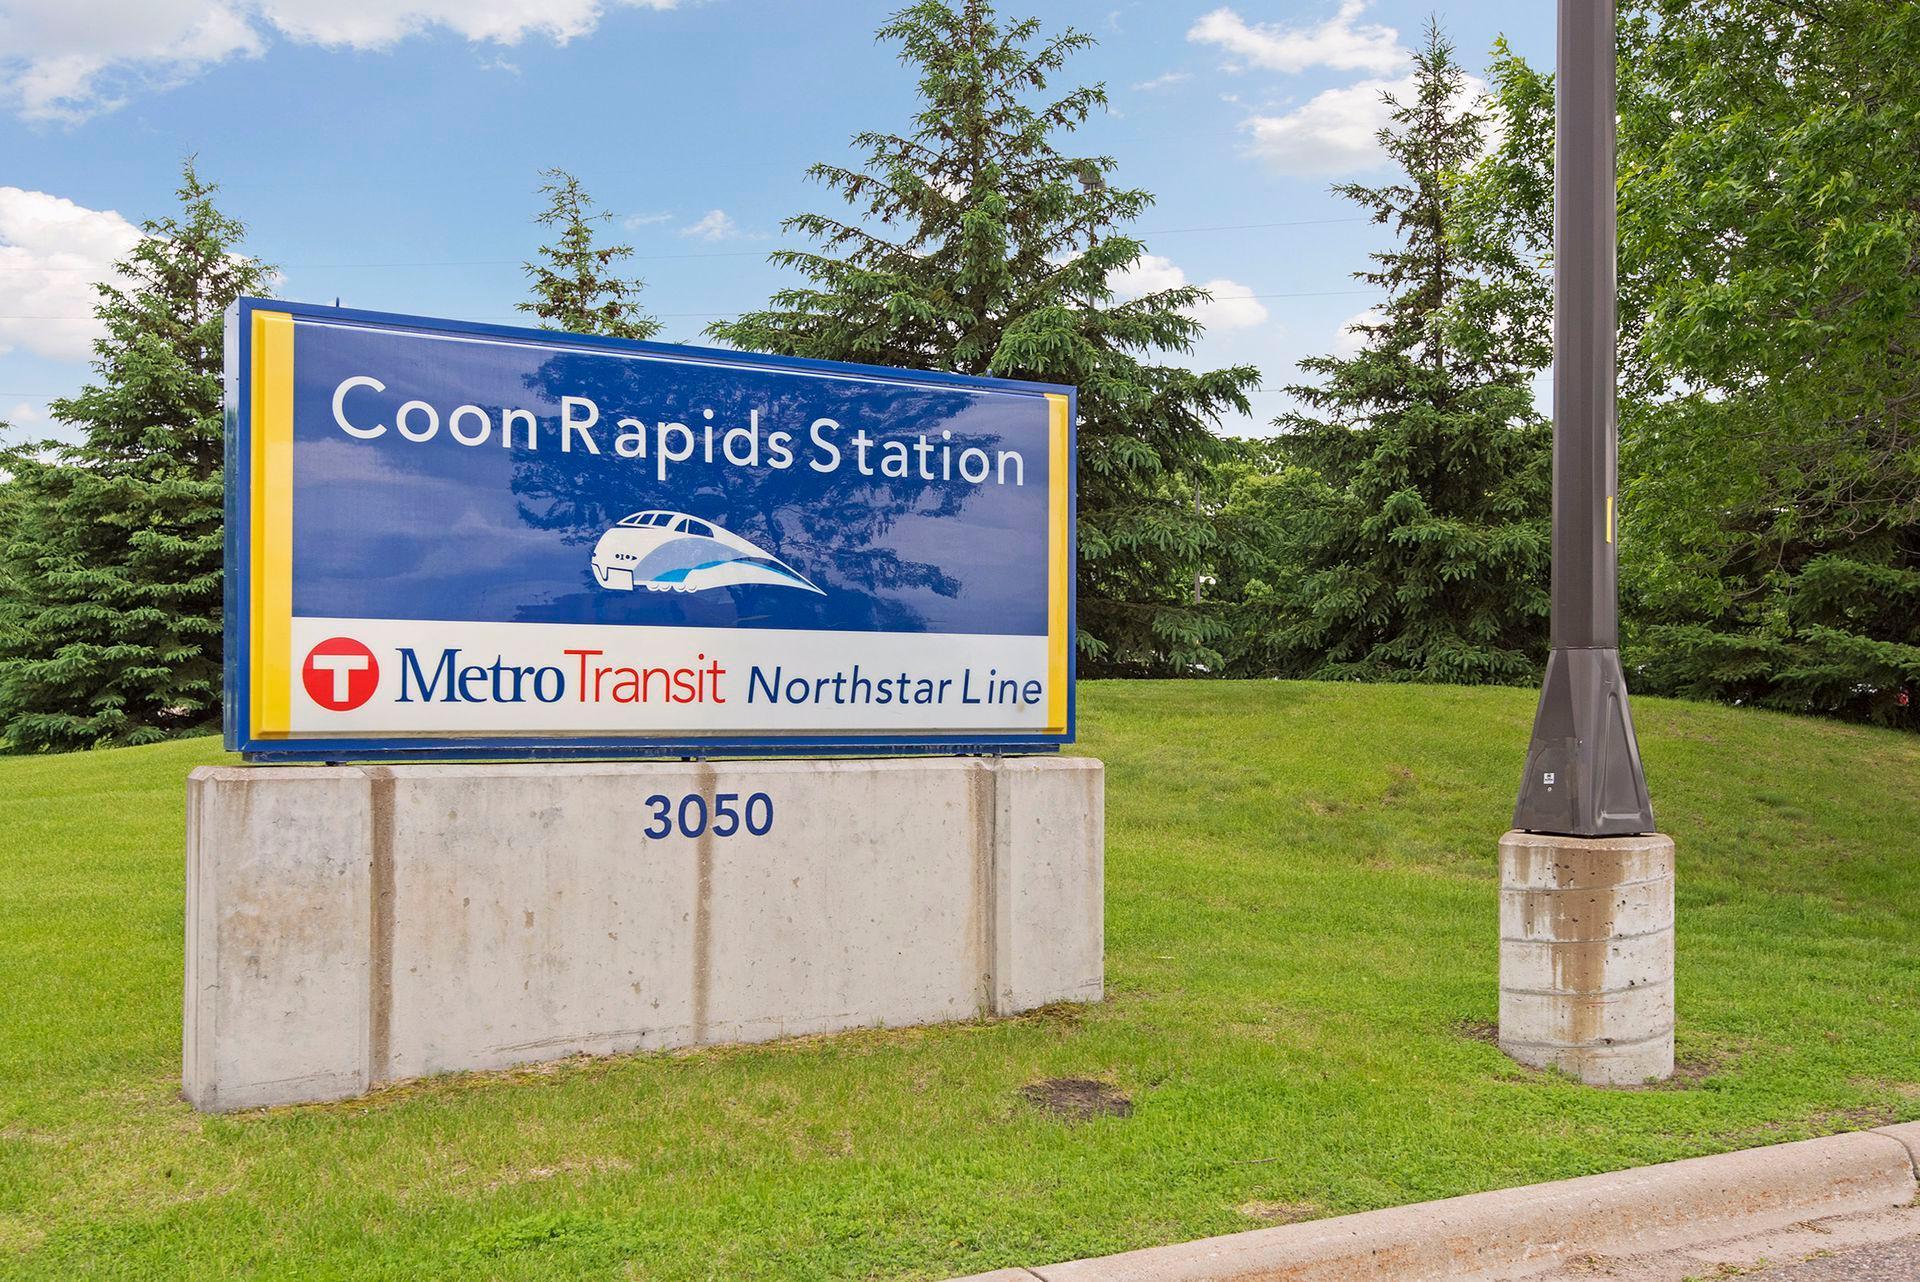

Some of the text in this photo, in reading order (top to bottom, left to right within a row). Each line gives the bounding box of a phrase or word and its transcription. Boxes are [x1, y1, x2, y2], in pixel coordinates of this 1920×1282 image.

[331, 375, 1024, 486] Coon Rapids Station
[747, 664, 953, 706] Northstar
[961, 667, 1042, 706] Line
[643, 791, 774, 840] 3050
